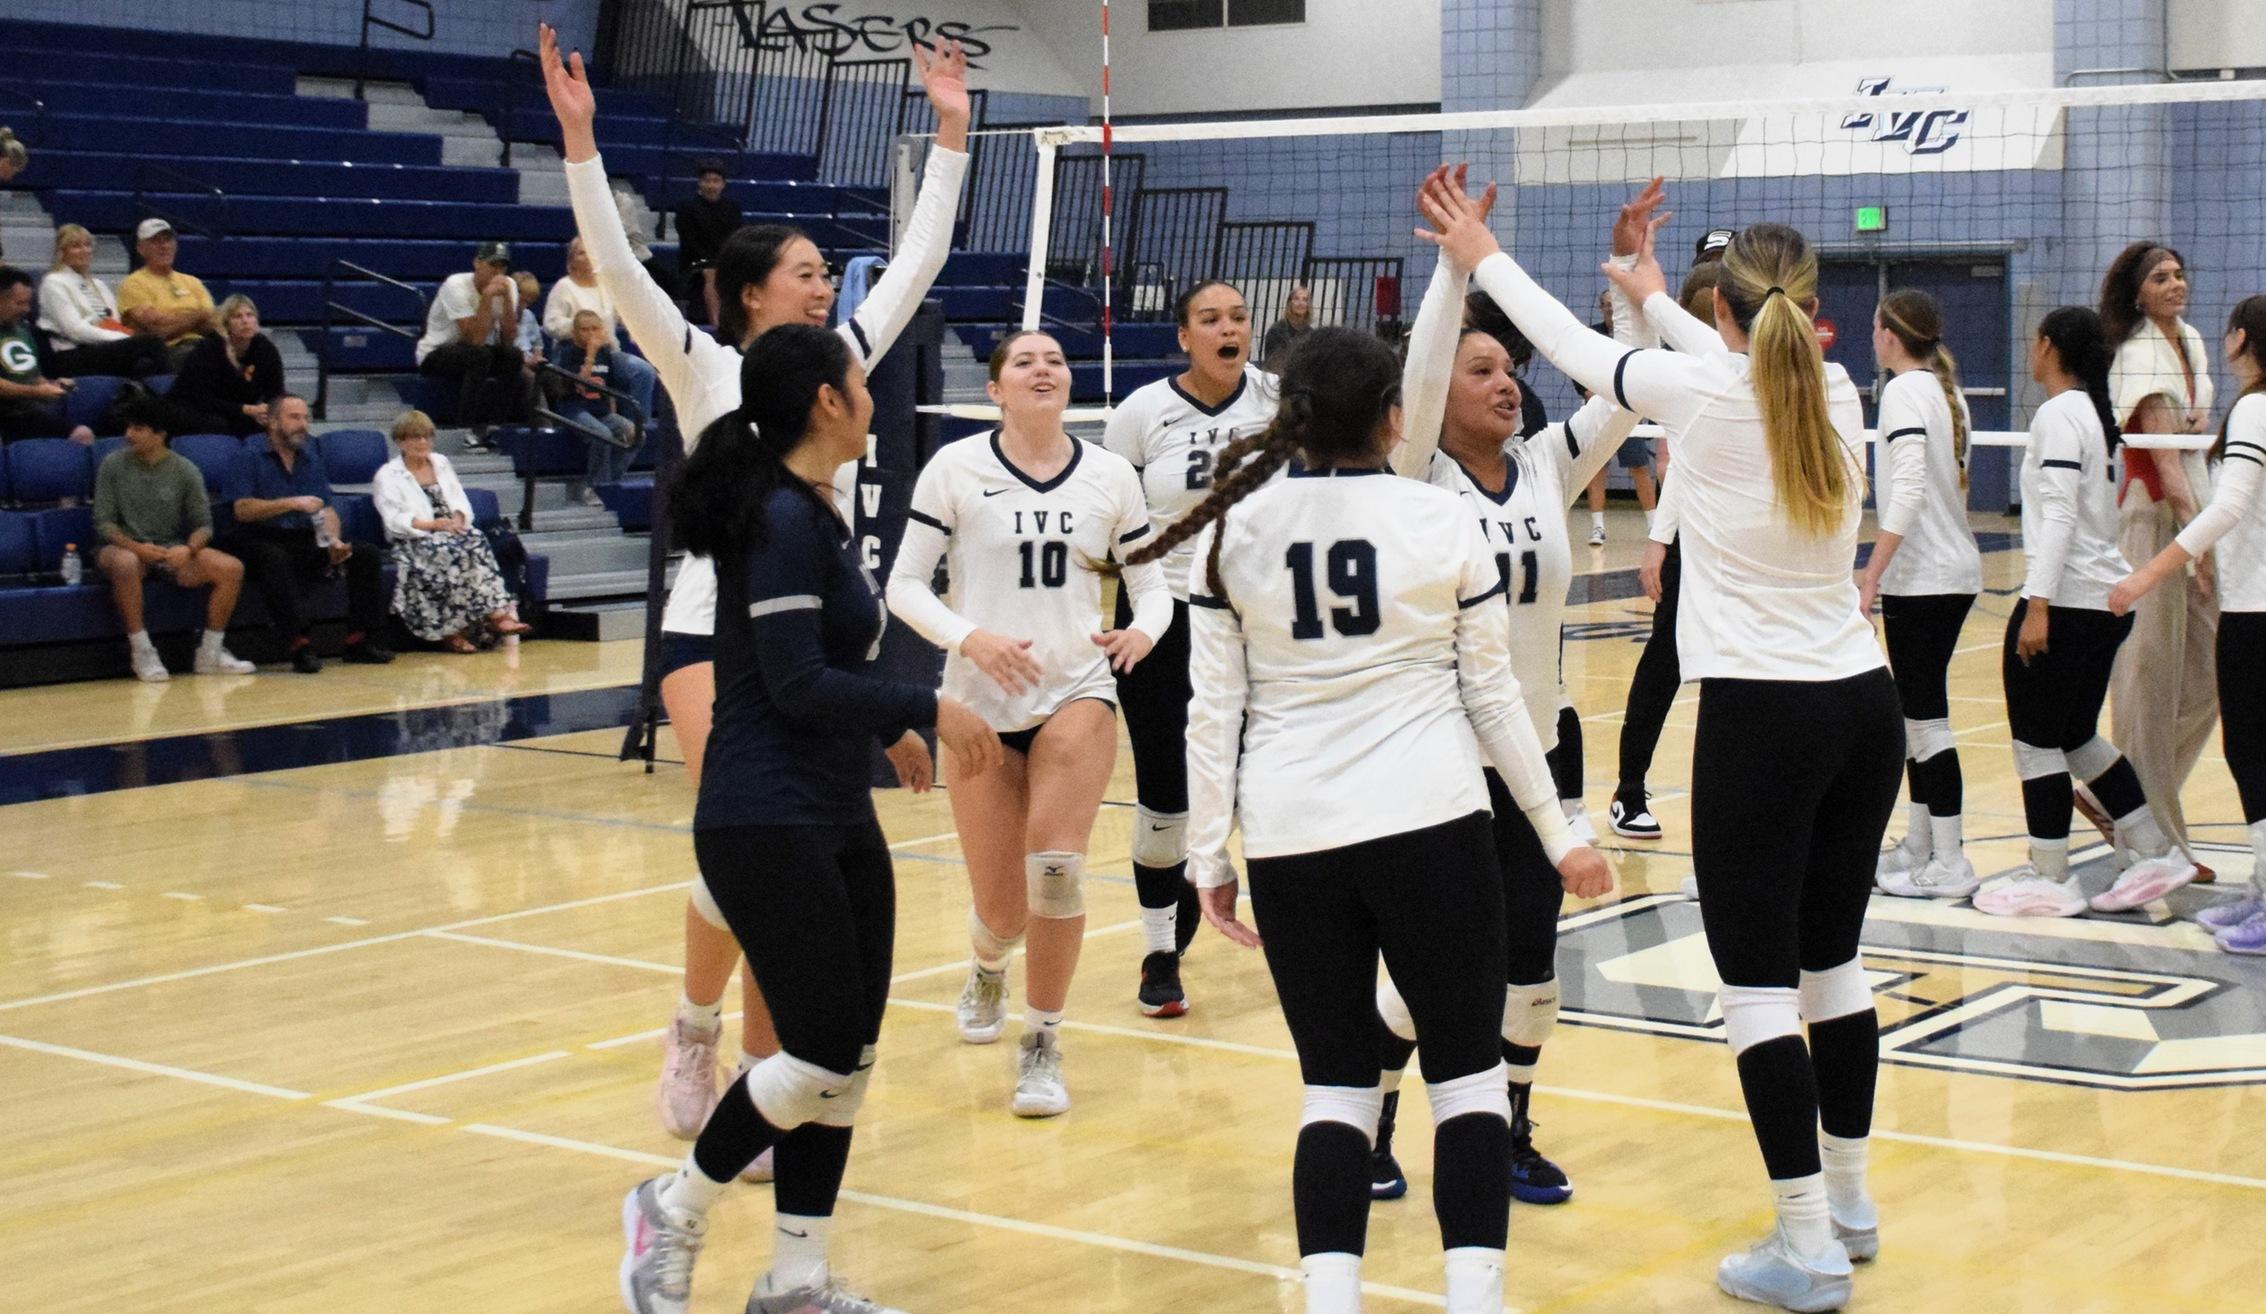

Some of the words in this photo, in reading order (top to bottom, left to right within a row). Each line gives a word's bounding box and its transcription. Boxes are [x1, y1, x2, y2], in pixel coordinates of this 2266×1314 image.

[0, 340, 37, 371] G
[1015, 510, 1073, 534] IVC
[1018, 541, 1068, 588] 10
[1495, 551, 1537, 604] 11
[1286, 539, 1381, 639] 19
